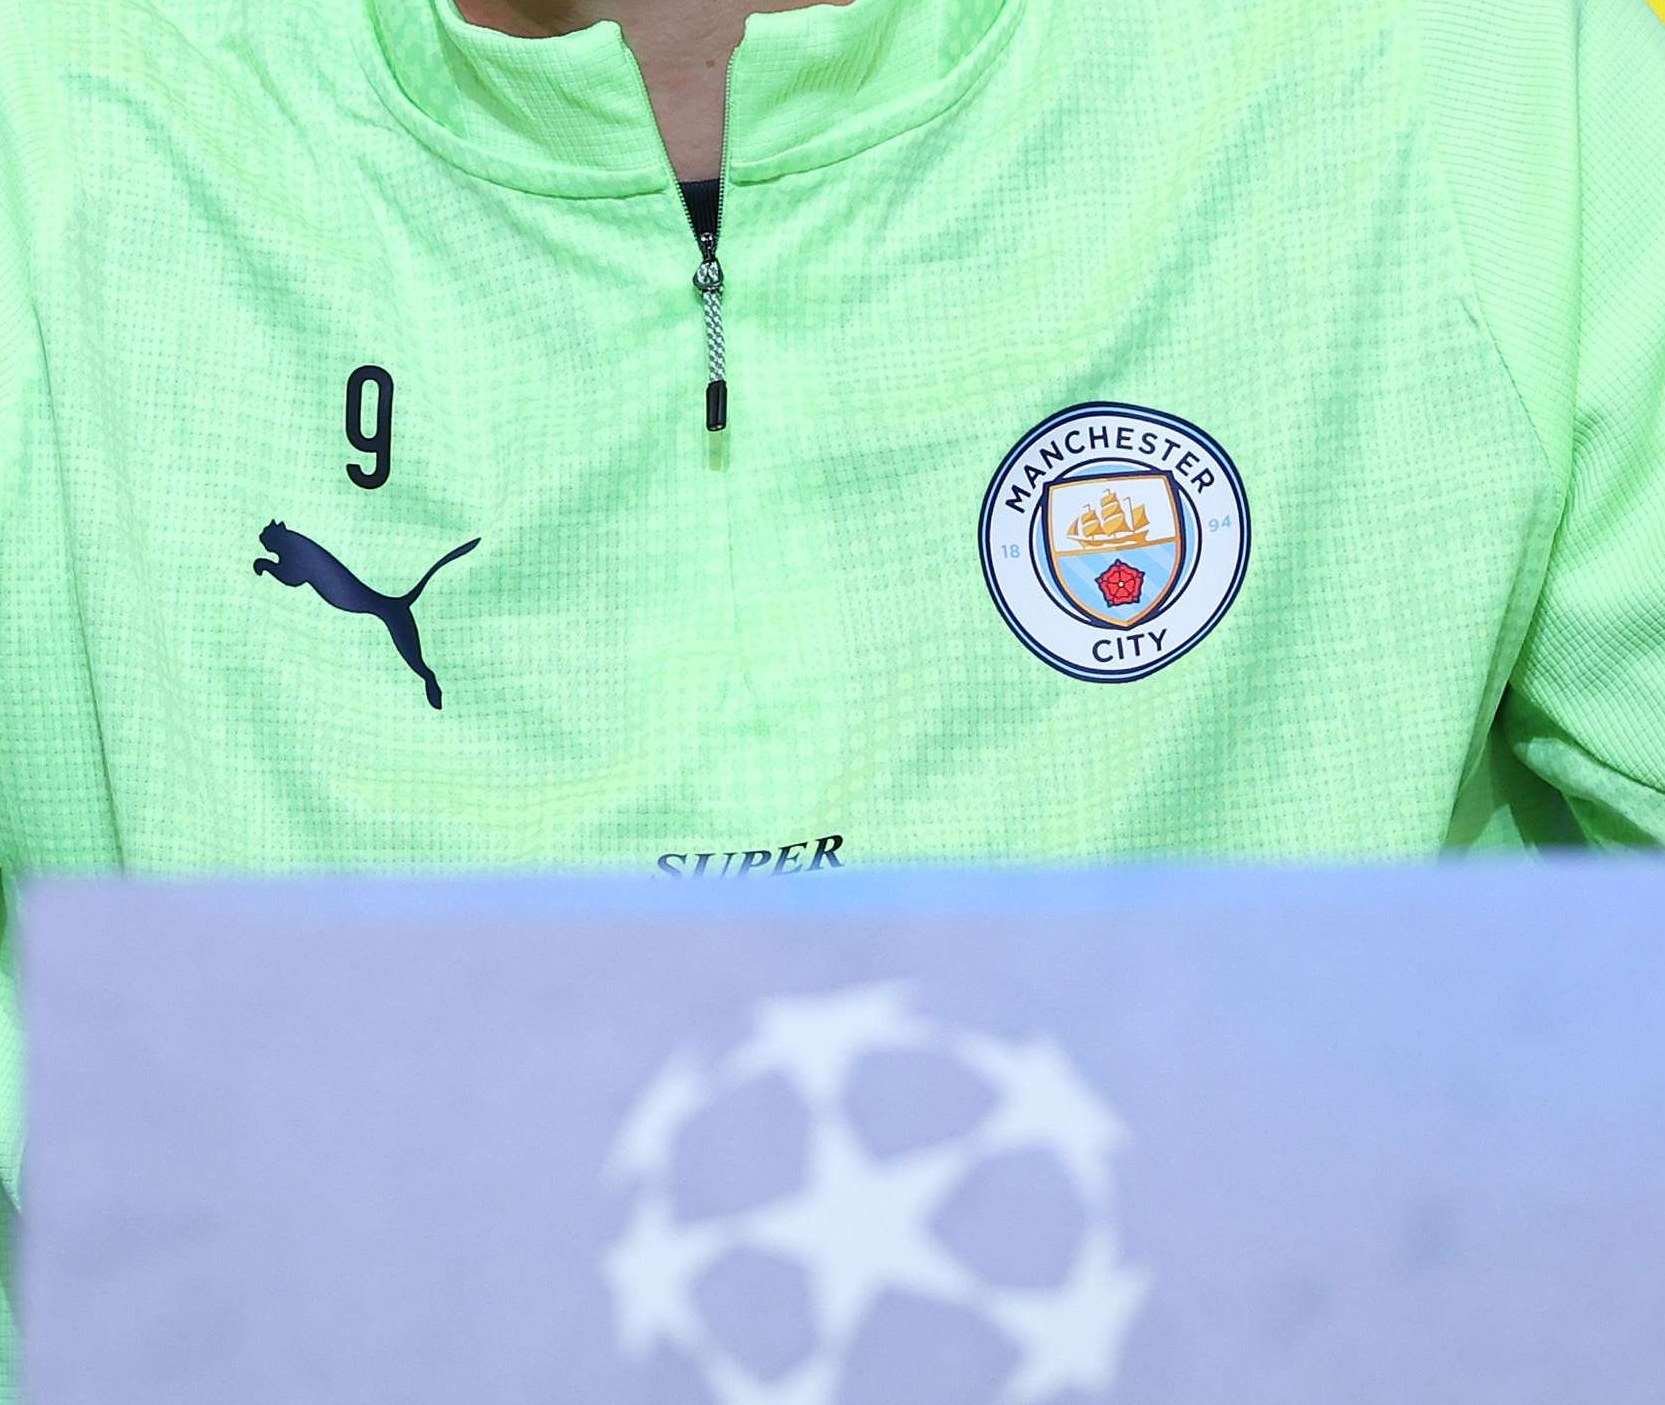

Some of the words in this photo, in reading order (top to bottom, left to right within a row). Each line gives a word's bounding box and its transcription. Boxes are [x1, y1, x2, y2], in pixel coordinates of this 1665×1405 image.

[345, 365, 394, 489] 9
[1004, 425, 1216, 514] MANCHESTER
[1208, 514, 1232, 533] 94
[1000, 544, 1021, 559] 18
[1091, 628, 1168, 663] CITY
[656, 833, 845, 879] SUPER
